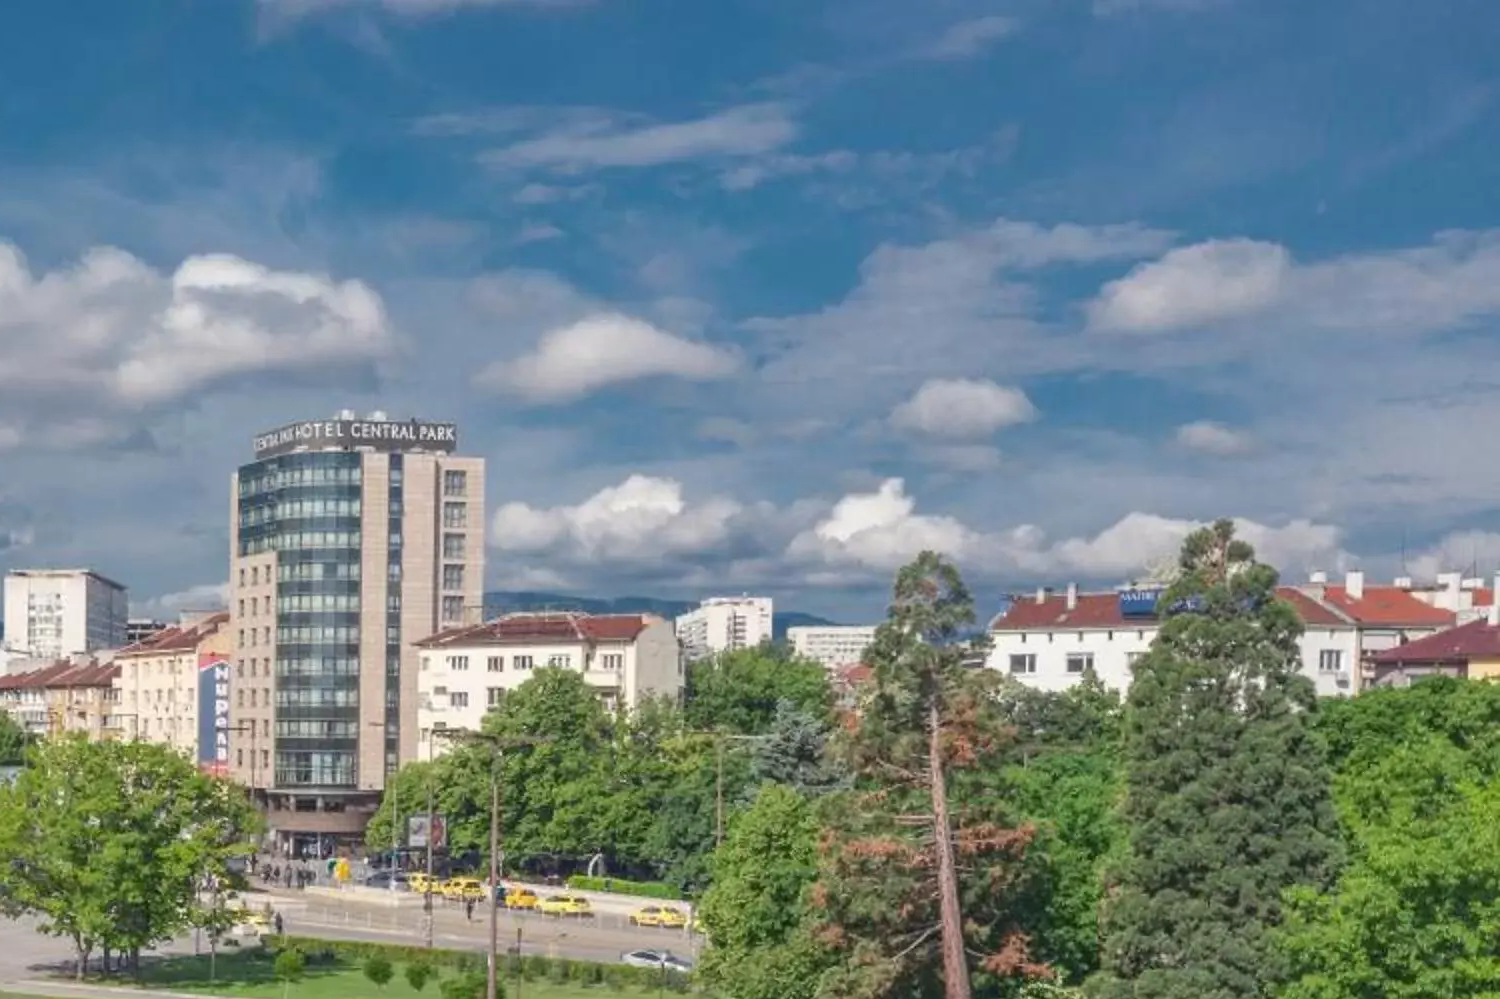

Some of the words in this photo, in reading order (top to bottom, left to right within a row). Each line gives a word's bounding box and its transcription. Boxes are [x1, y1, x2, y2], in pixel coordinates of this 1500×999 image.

[295, 422, 345, 438] HOTEL
[350, 423, 416, 440] CENTRAL
[419, 425, 454, 441] PARK
